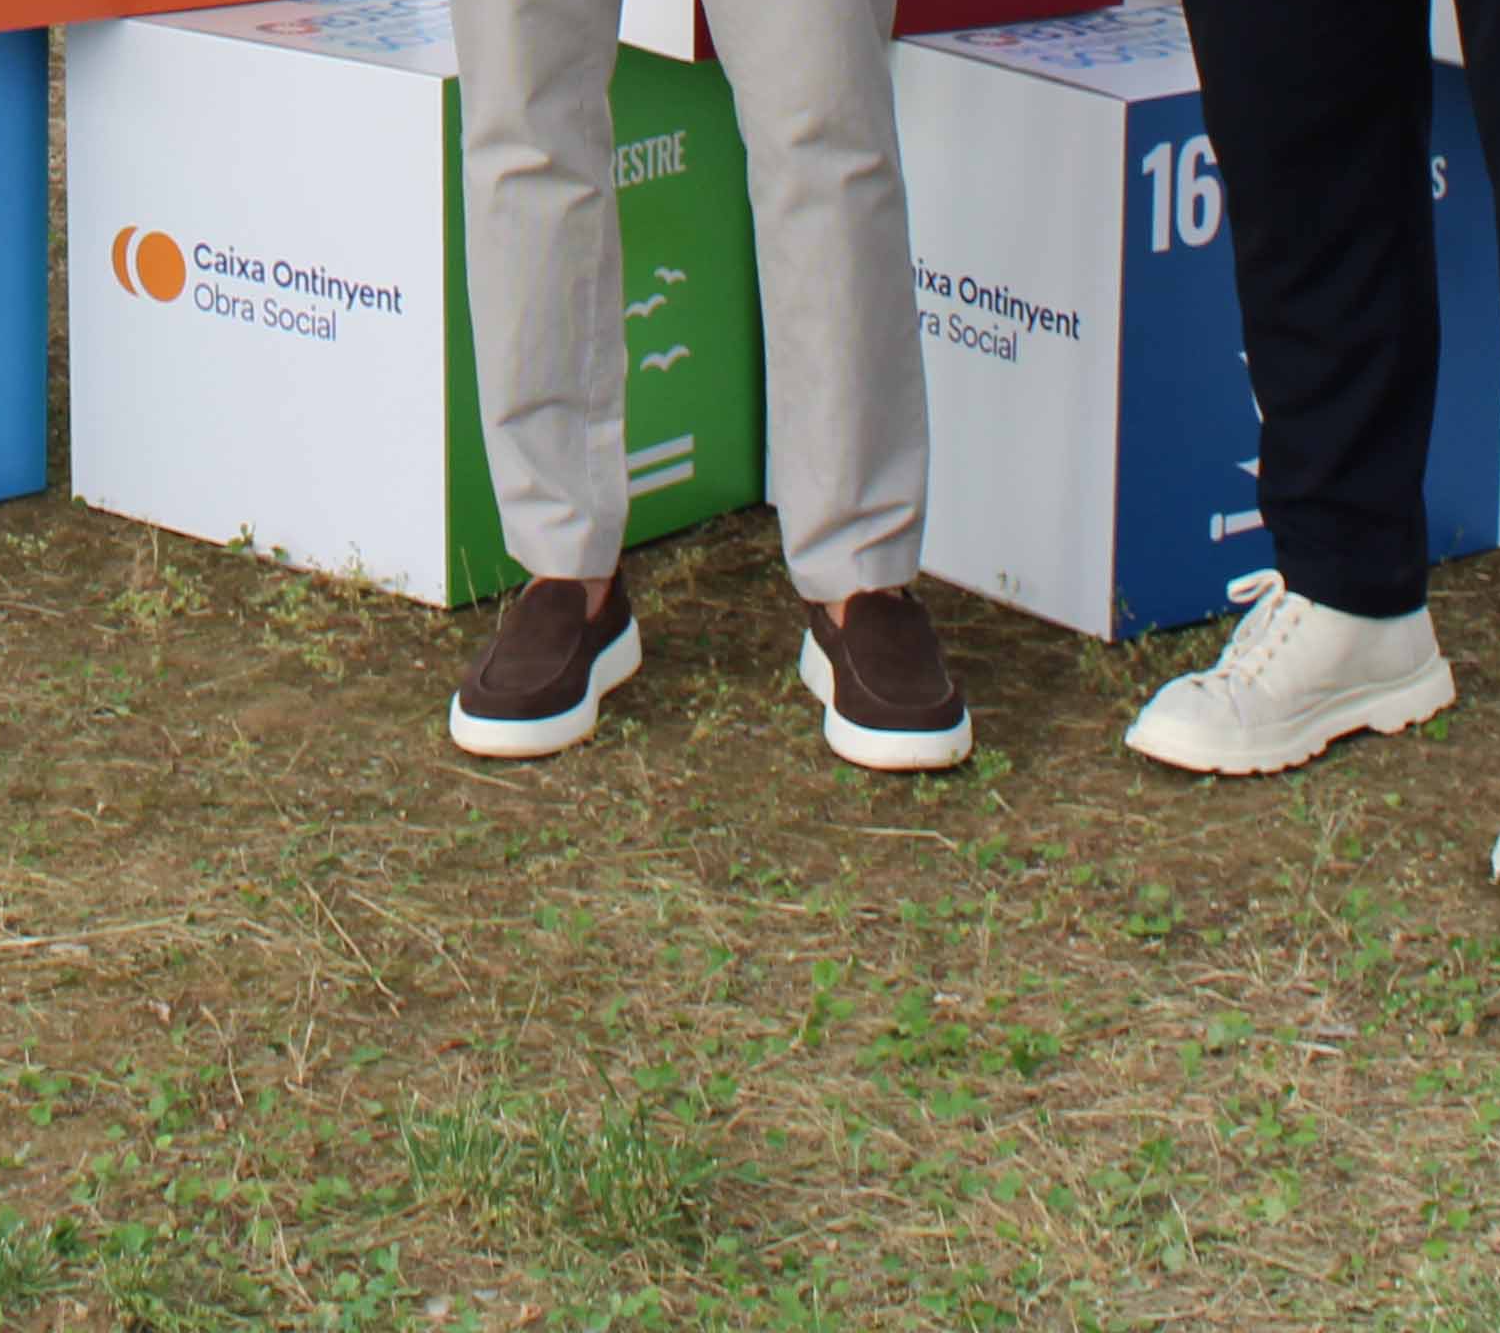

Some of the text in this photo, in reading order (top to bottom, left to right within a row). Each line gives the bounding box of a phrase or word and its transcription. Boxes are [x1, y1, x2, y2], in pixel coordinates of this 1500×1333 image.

[1141, 134, 1223, 253] 16
[194, 242, 403, 315] Caixa Ontinyent
[194, 282, 337, 342] Obra Social
[912, 258, 1081, 341] ixa Ontinyent
[949, 313, 1018, 363] Social
